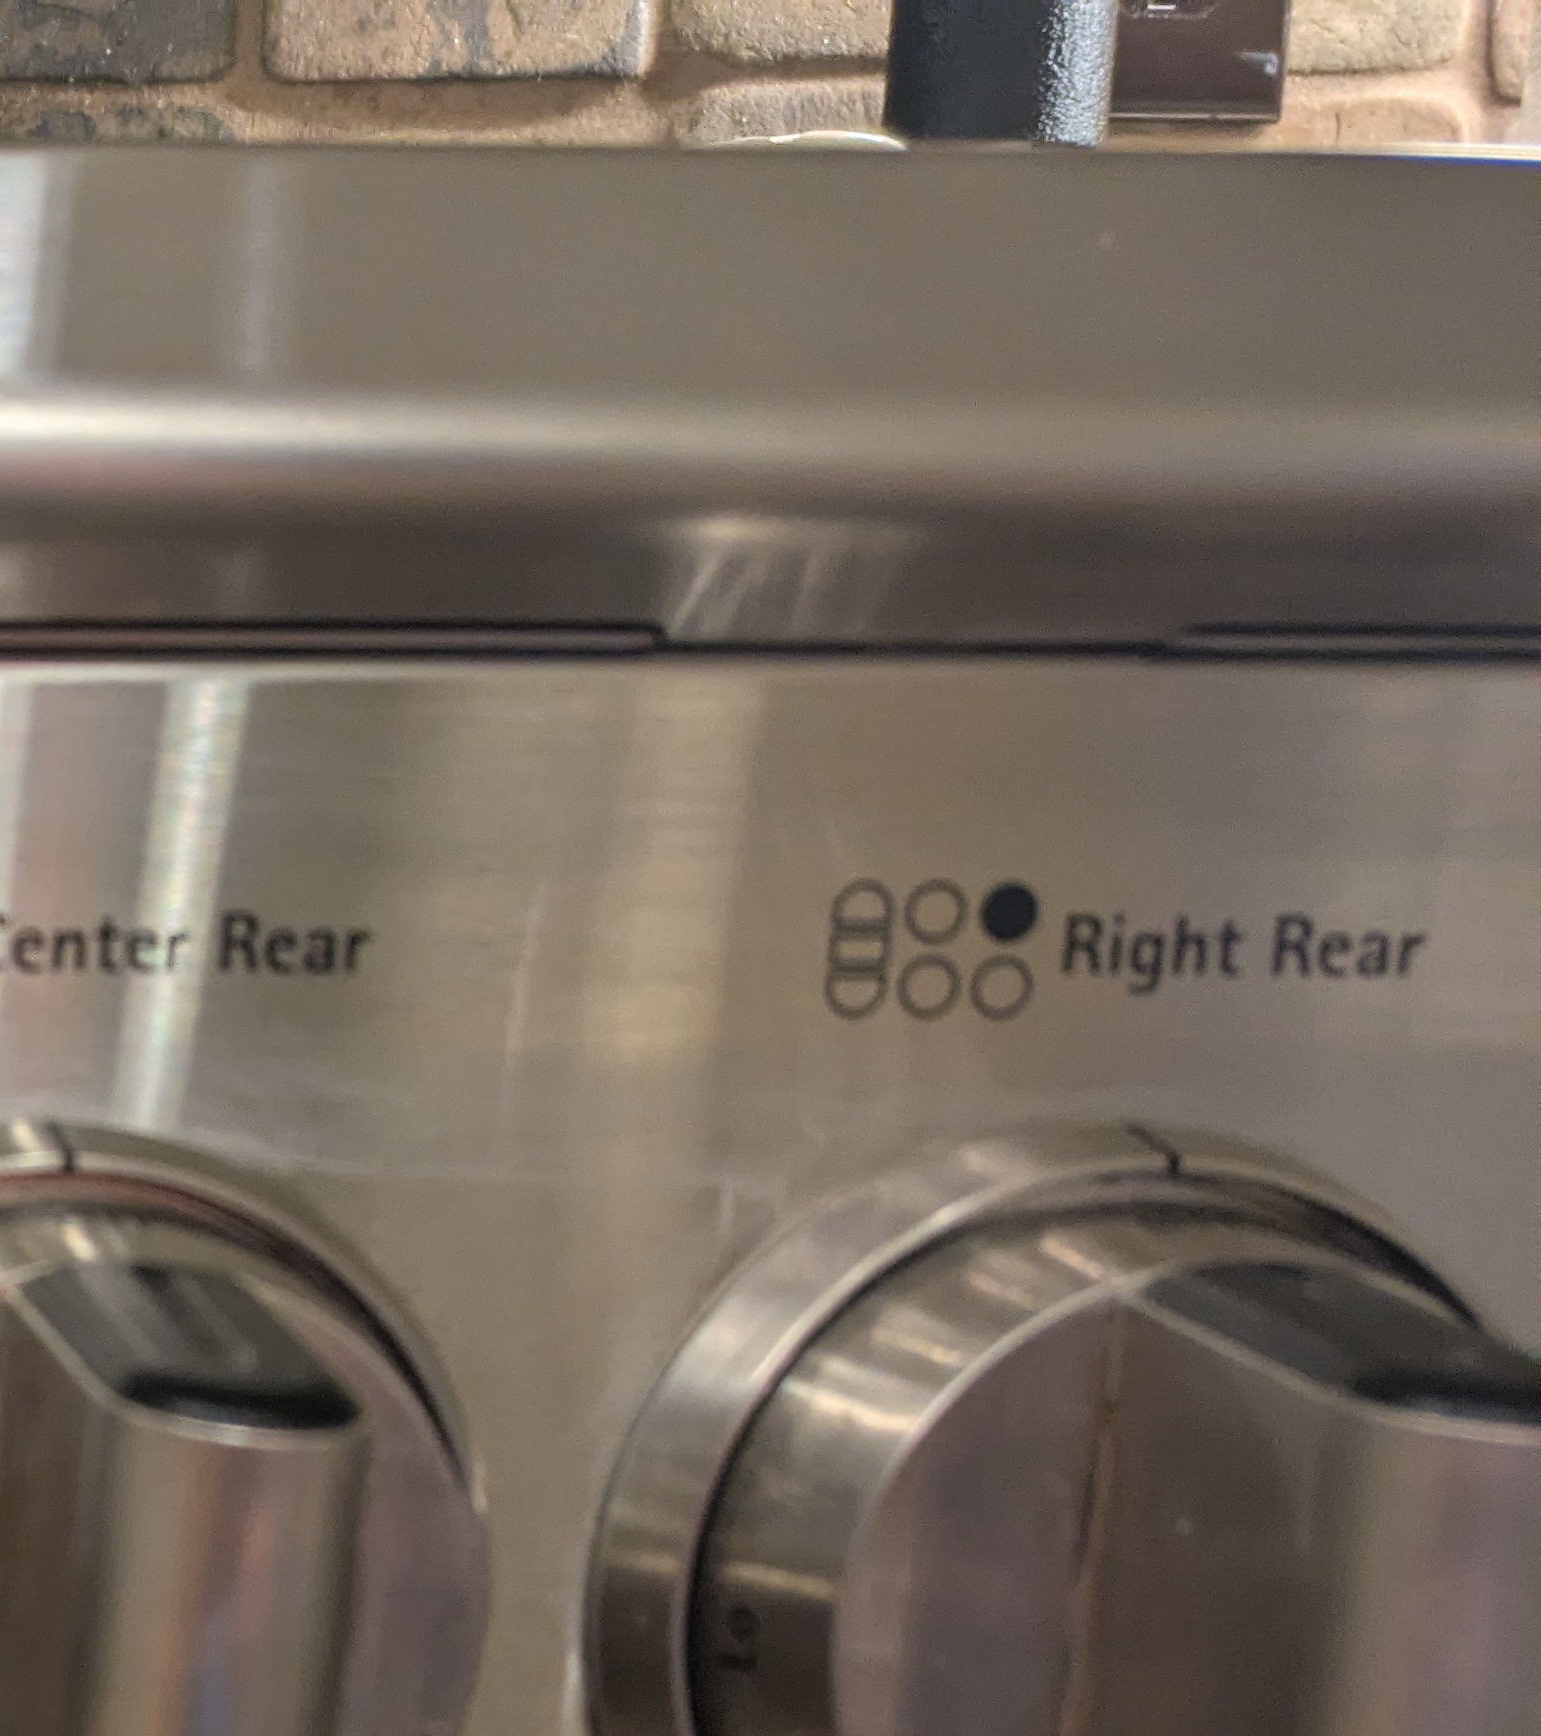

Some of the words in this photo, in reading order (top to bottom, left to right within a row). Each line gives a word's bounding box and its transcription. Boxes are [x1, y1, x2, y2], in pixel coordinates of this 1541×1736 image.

[220, 908, 372, 975] Rear
[1060, 911, 1244, 998] Right
[1270, 912, 1425, 978] Rear
